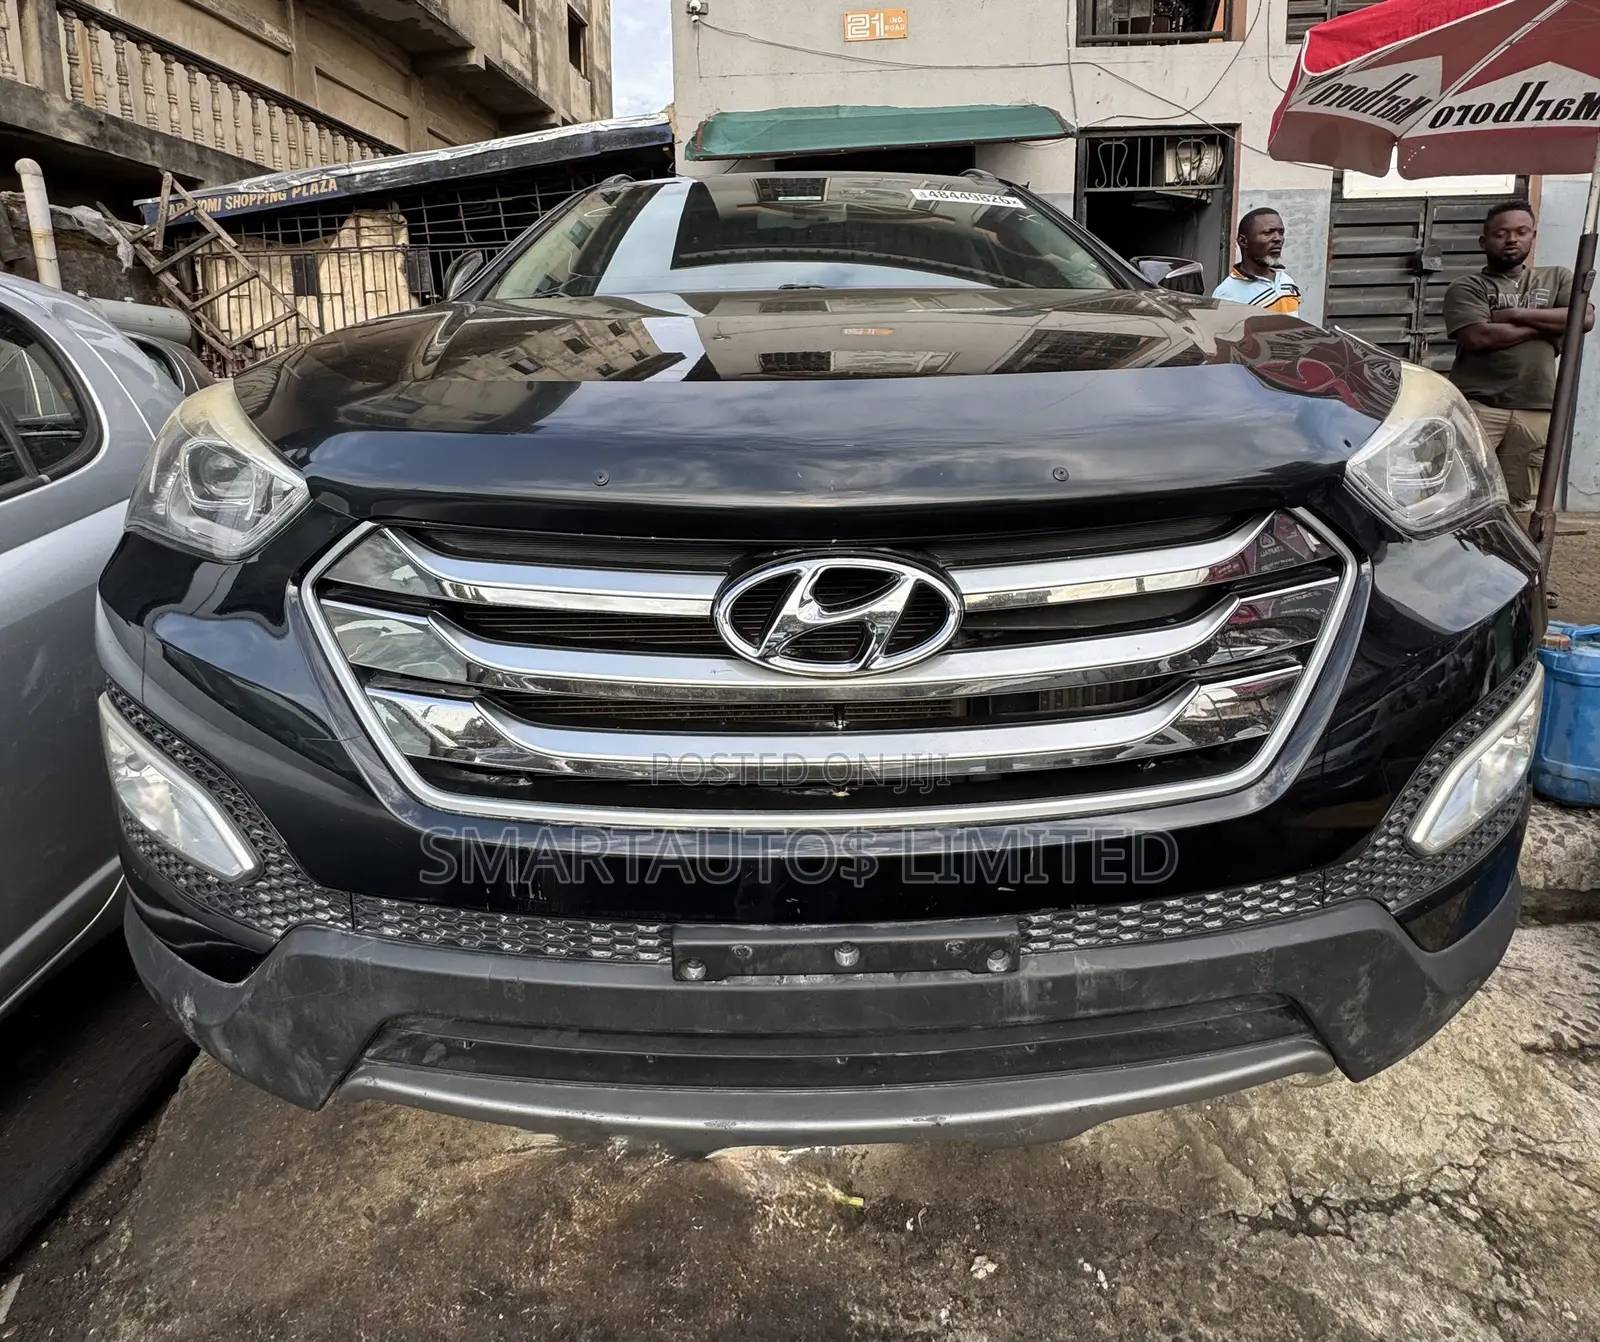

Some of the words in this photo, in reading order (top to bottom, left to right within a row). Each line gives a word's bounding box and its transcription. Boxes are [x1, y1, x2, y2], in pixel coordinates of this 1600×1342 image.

[847, 12, 885, 39] 21
[884, 24, 905, 32] ROAD
[225, 191, 288, 210] SHOPPING
[291, 178, 338, 199] PLAZA
